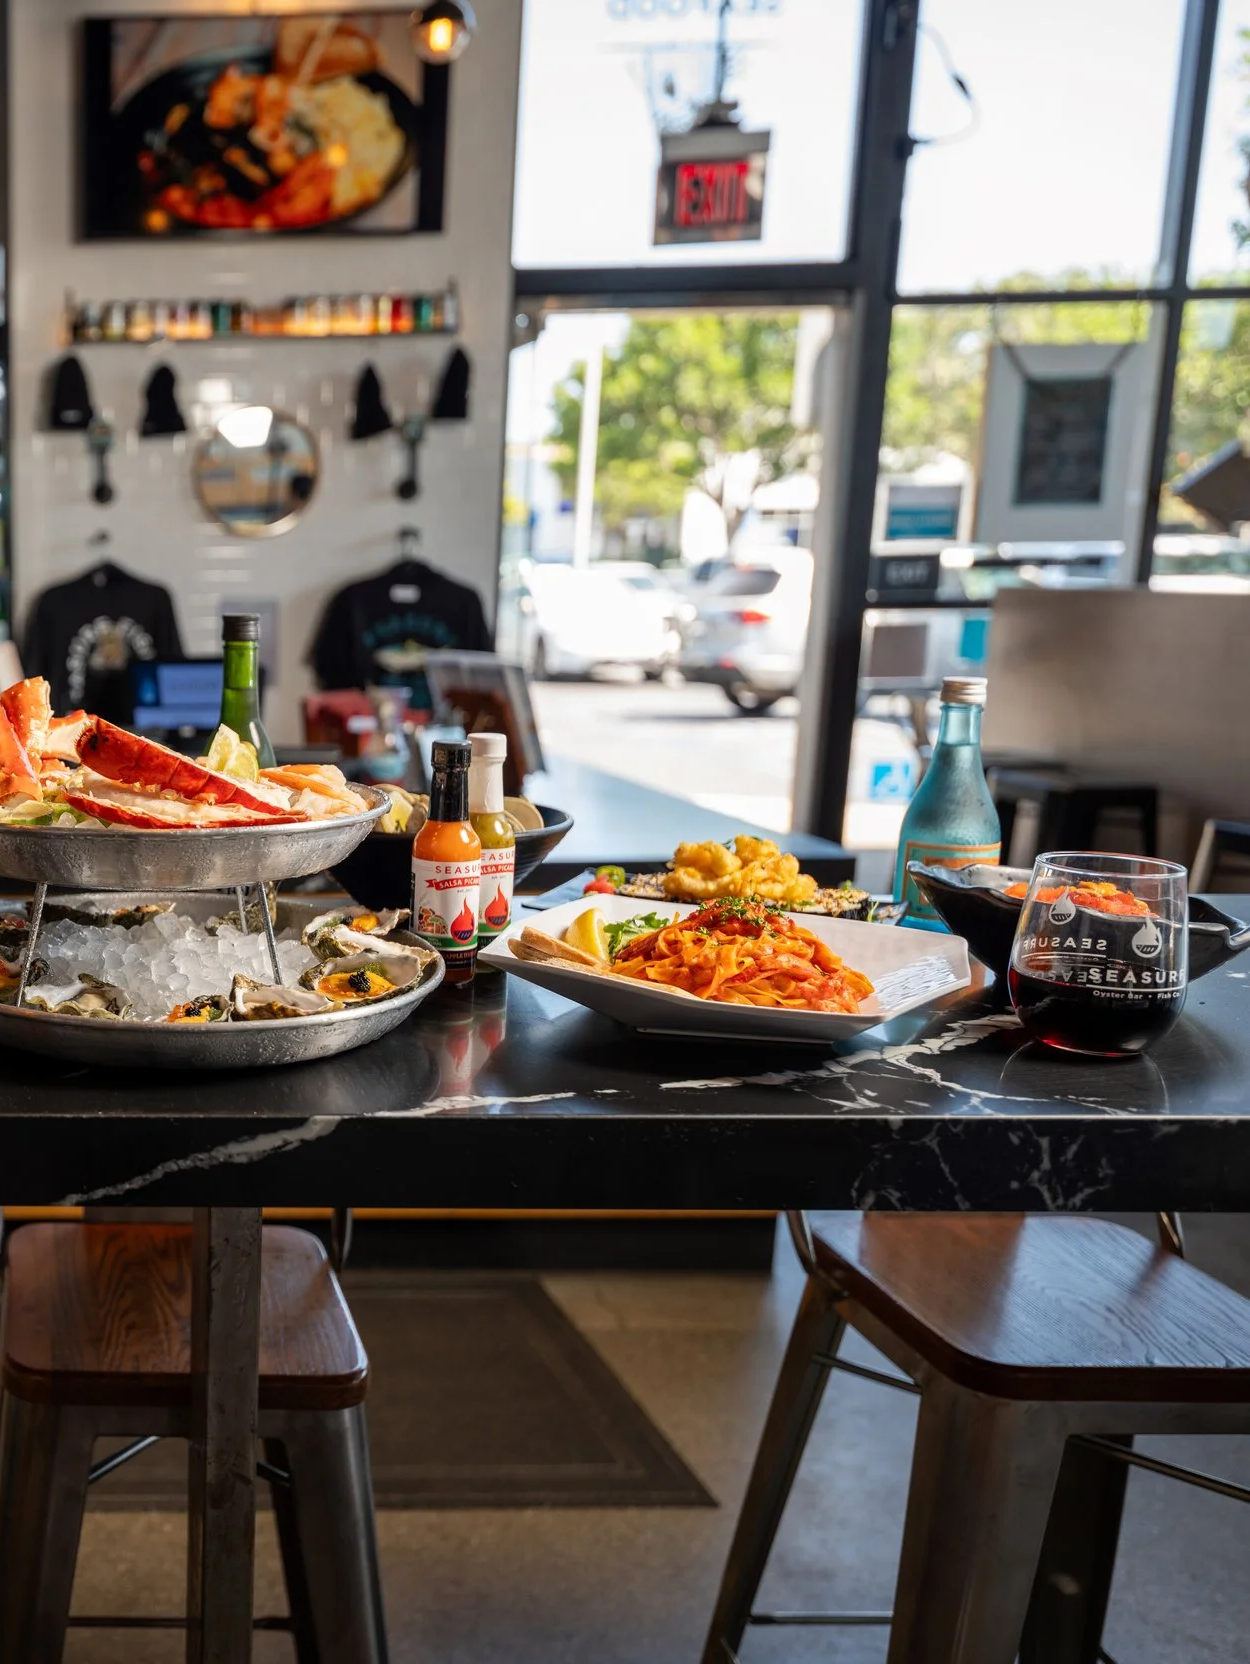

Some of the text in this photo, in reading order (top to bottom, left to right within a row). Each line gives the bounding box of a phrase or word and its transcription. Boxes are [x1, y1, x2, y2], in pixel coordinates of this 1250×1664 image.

[481, 851, 514, 861] EASU
[435, 864, 480, 874] SEASU
[440, 879, 463, 889] SALSA
[1088, 968, 1185, 983] SEASURF
[1093, 990, 1124, 999] Oyster
